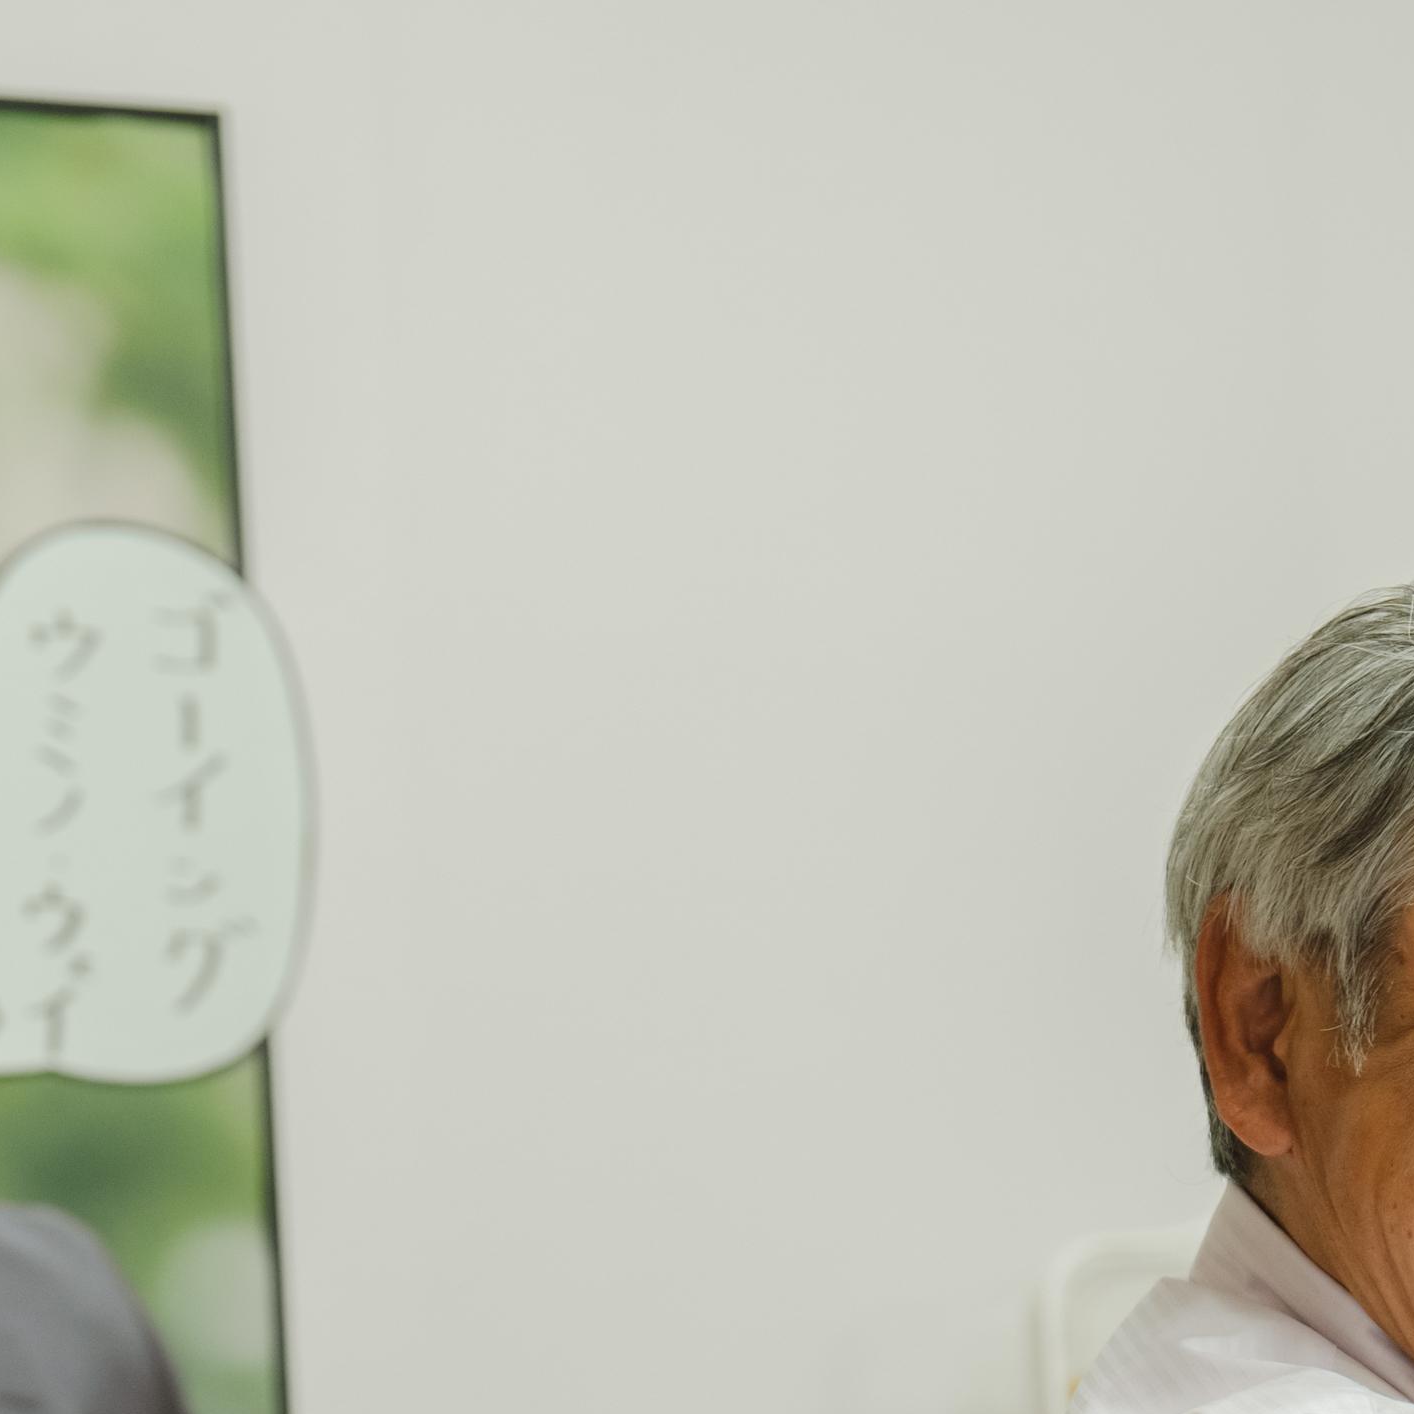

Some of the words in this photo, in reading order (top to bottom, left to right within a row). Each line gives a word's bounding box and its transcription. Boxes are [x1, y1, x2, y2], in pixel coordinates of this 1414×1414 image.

[153, 592, 258, 1015] ゴーイング
